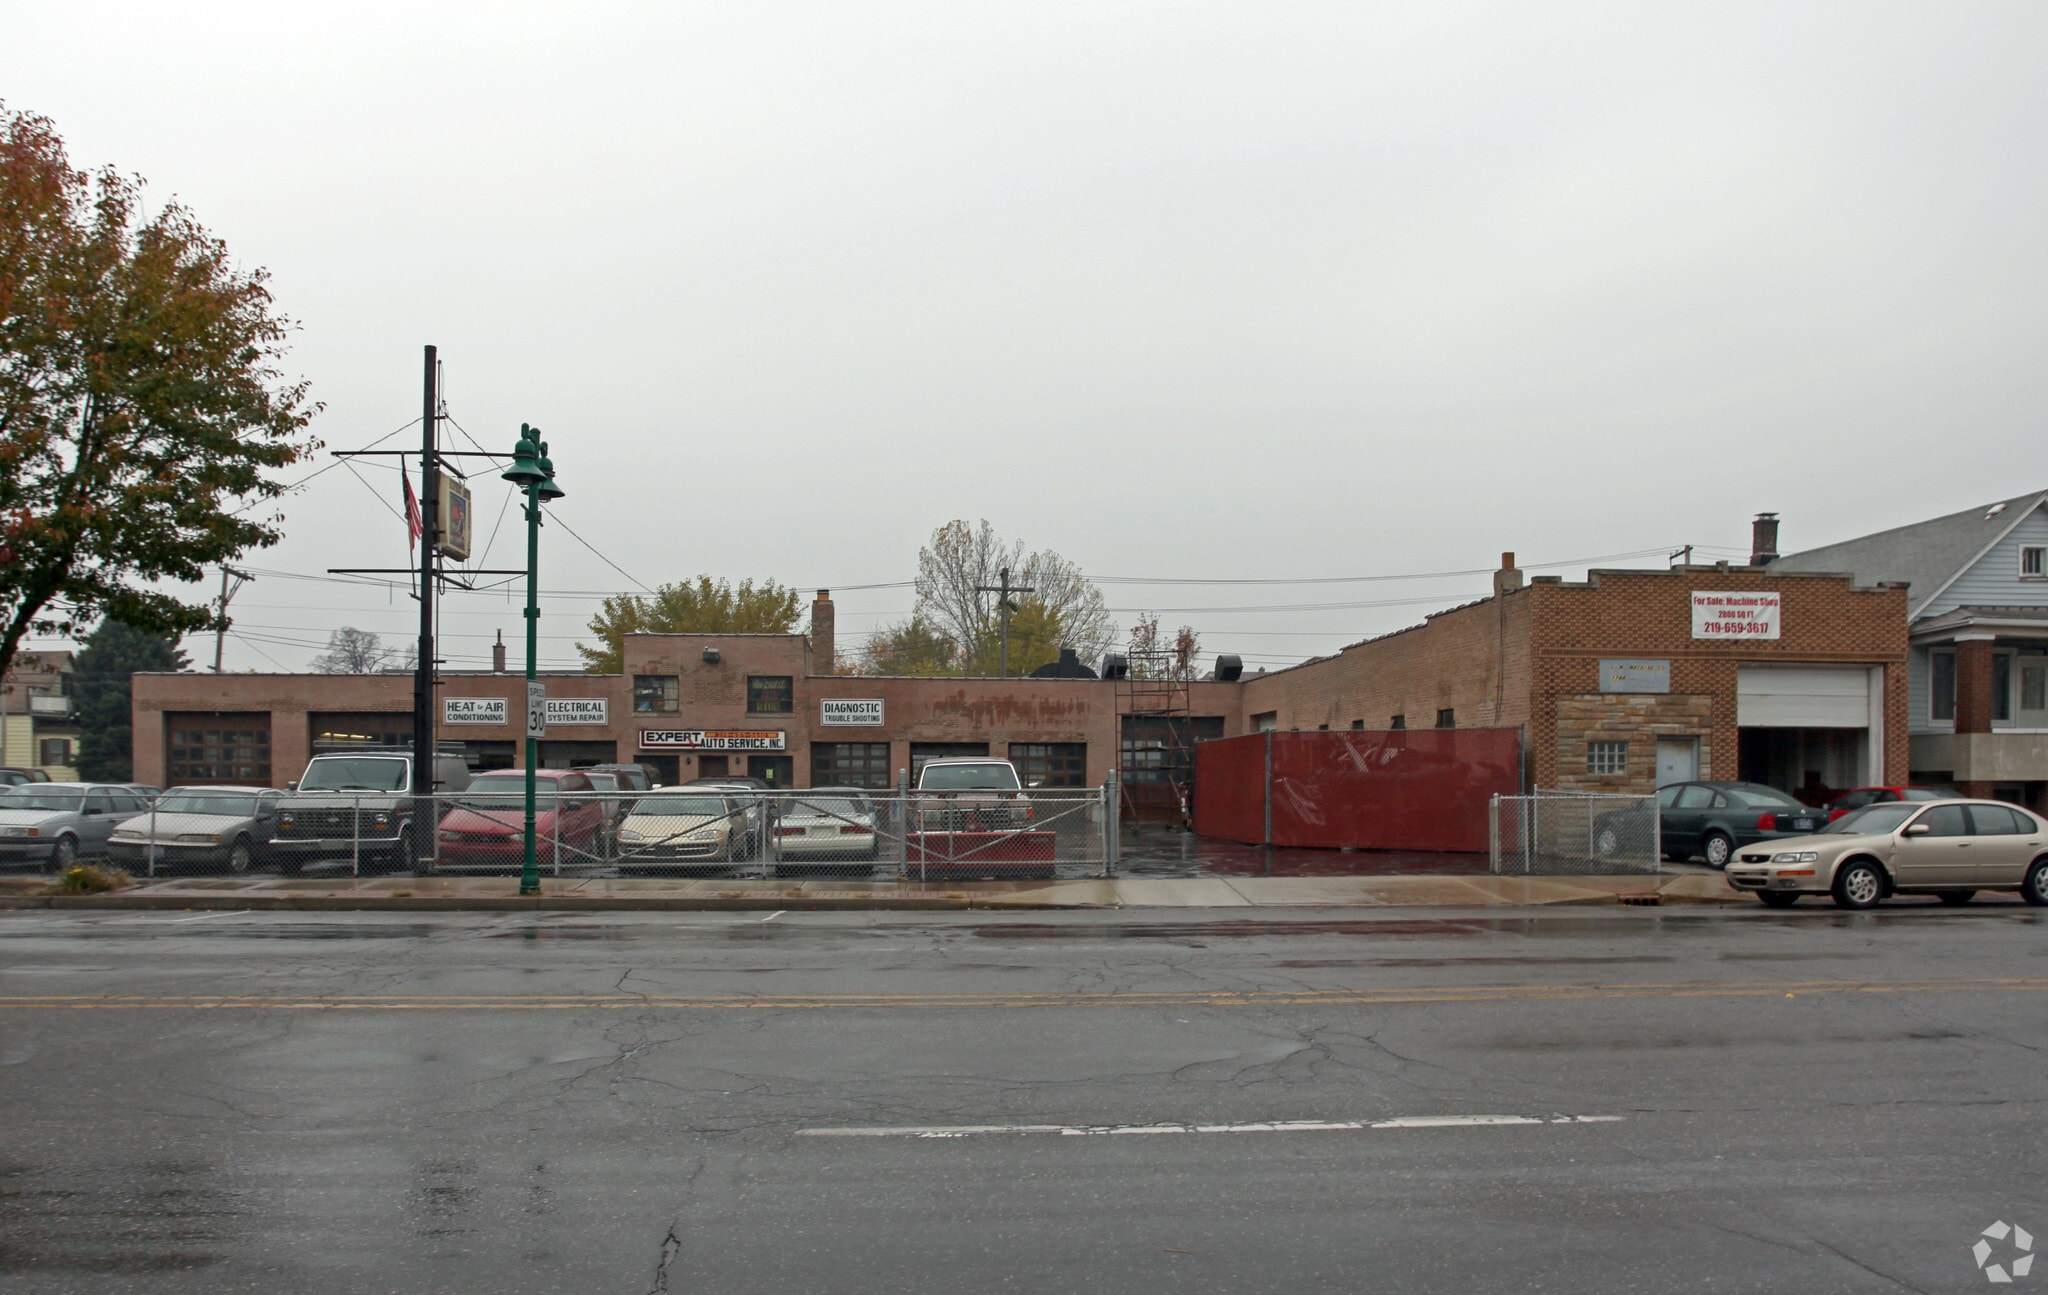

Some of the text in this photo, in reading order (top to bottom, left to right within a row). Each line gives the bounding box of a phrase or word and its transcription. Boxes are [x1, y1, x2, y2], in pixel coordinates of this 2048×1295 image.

[1694, 597, 1778, 607] For Sale: Machine Shop
[1737, 611, 1746, 619] SQ
[1747, 611, 1755, 619] FT
[1704, 621, 1769, 634] 219-659-3617
[530, 687, 545, 698] SPEED
[447, 702, 475, 712] HEAT
[485, 702, 504, 712] AIR
[547, 702, 604, 713] ELECTRICAL
[824, 703, 881, 713] DIAGNOSTIC
[447, 713, 504, 722] CONDITIONING
[529, 710, 545, 732] 30
[547, 714, 604, 722] SYSTEM REPAIR
[646, 731, 701, 742] EXPERT
[700, 738, 784, 749] AUTO SERVICE, INC.
